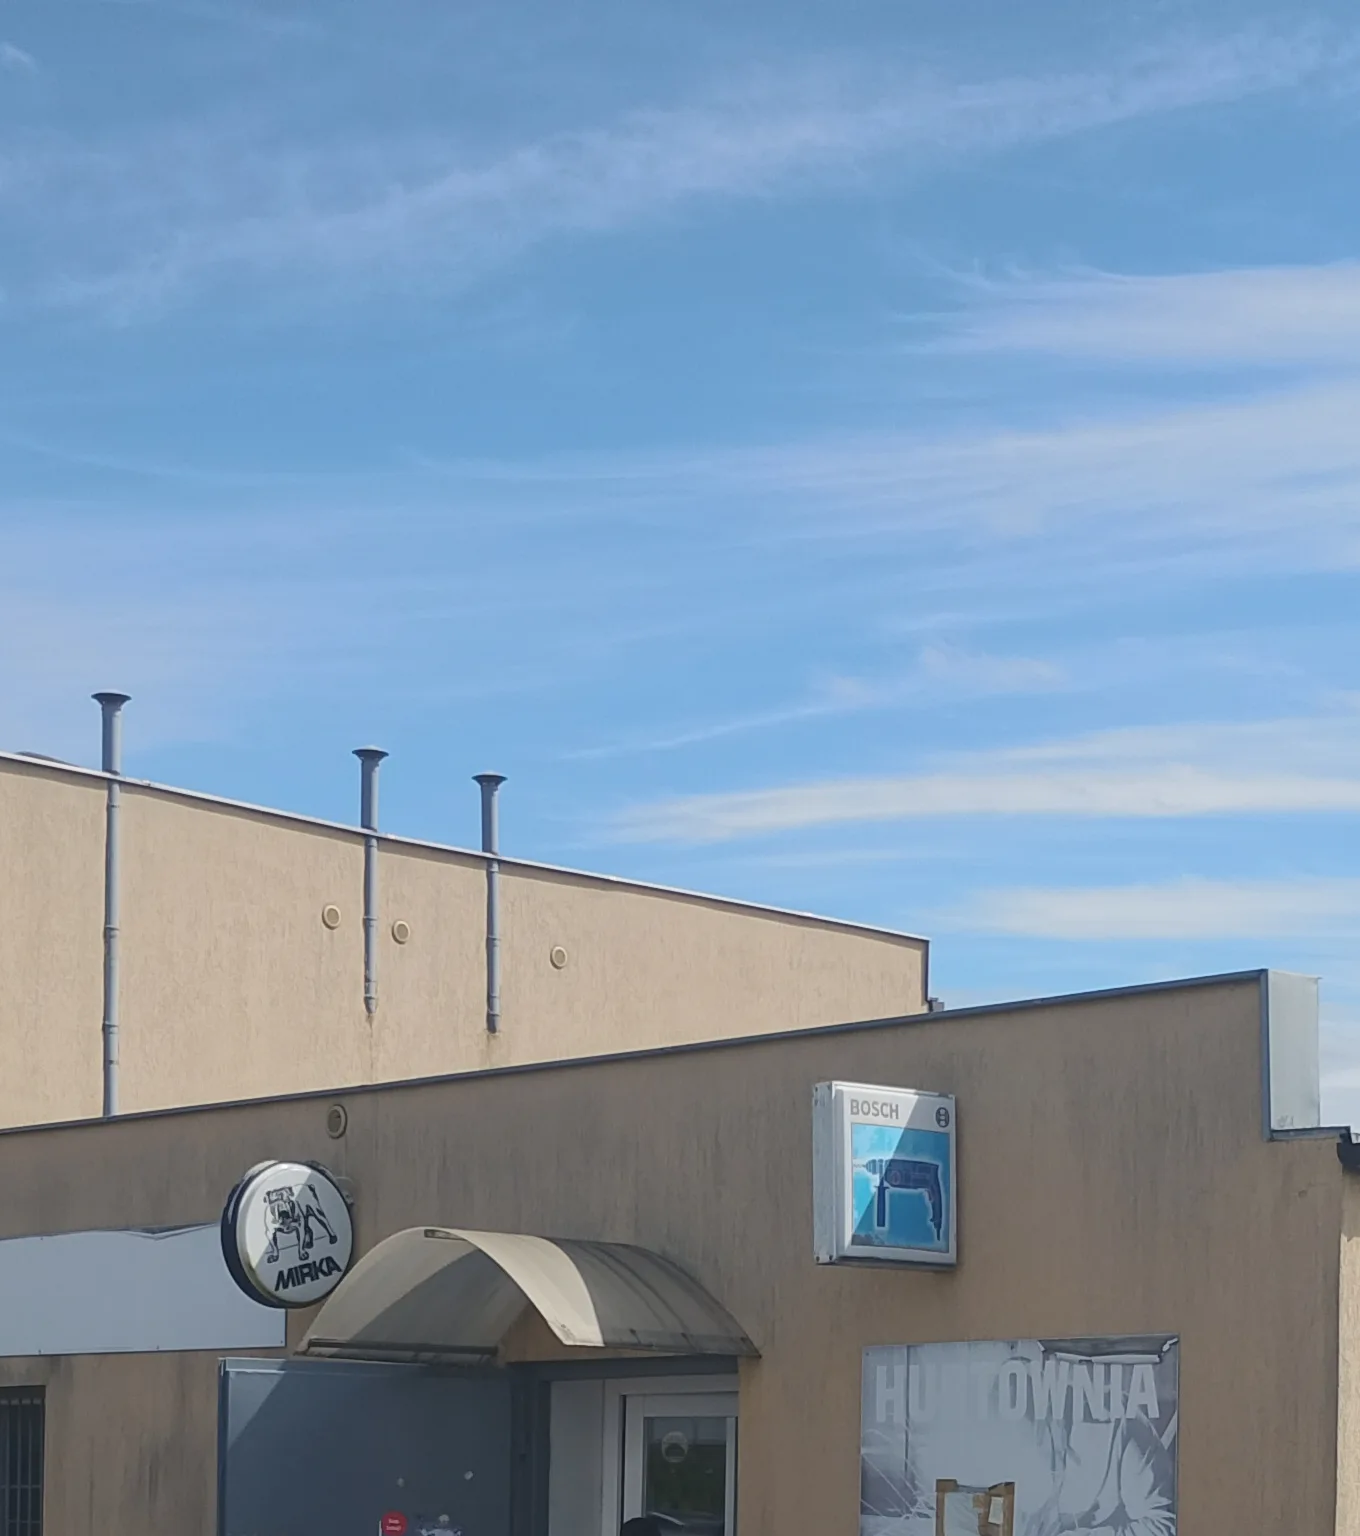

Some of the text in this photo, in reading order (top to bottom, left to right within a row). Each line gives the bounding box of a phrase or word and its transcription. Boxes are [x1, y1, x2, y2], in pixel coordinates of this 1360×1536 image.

[850, 1099, 900, 1120] BOSCH
[274, 1256, 343, 1292] MIRKA
[874, 1358, 1161, 1424] HUTOWNIA
